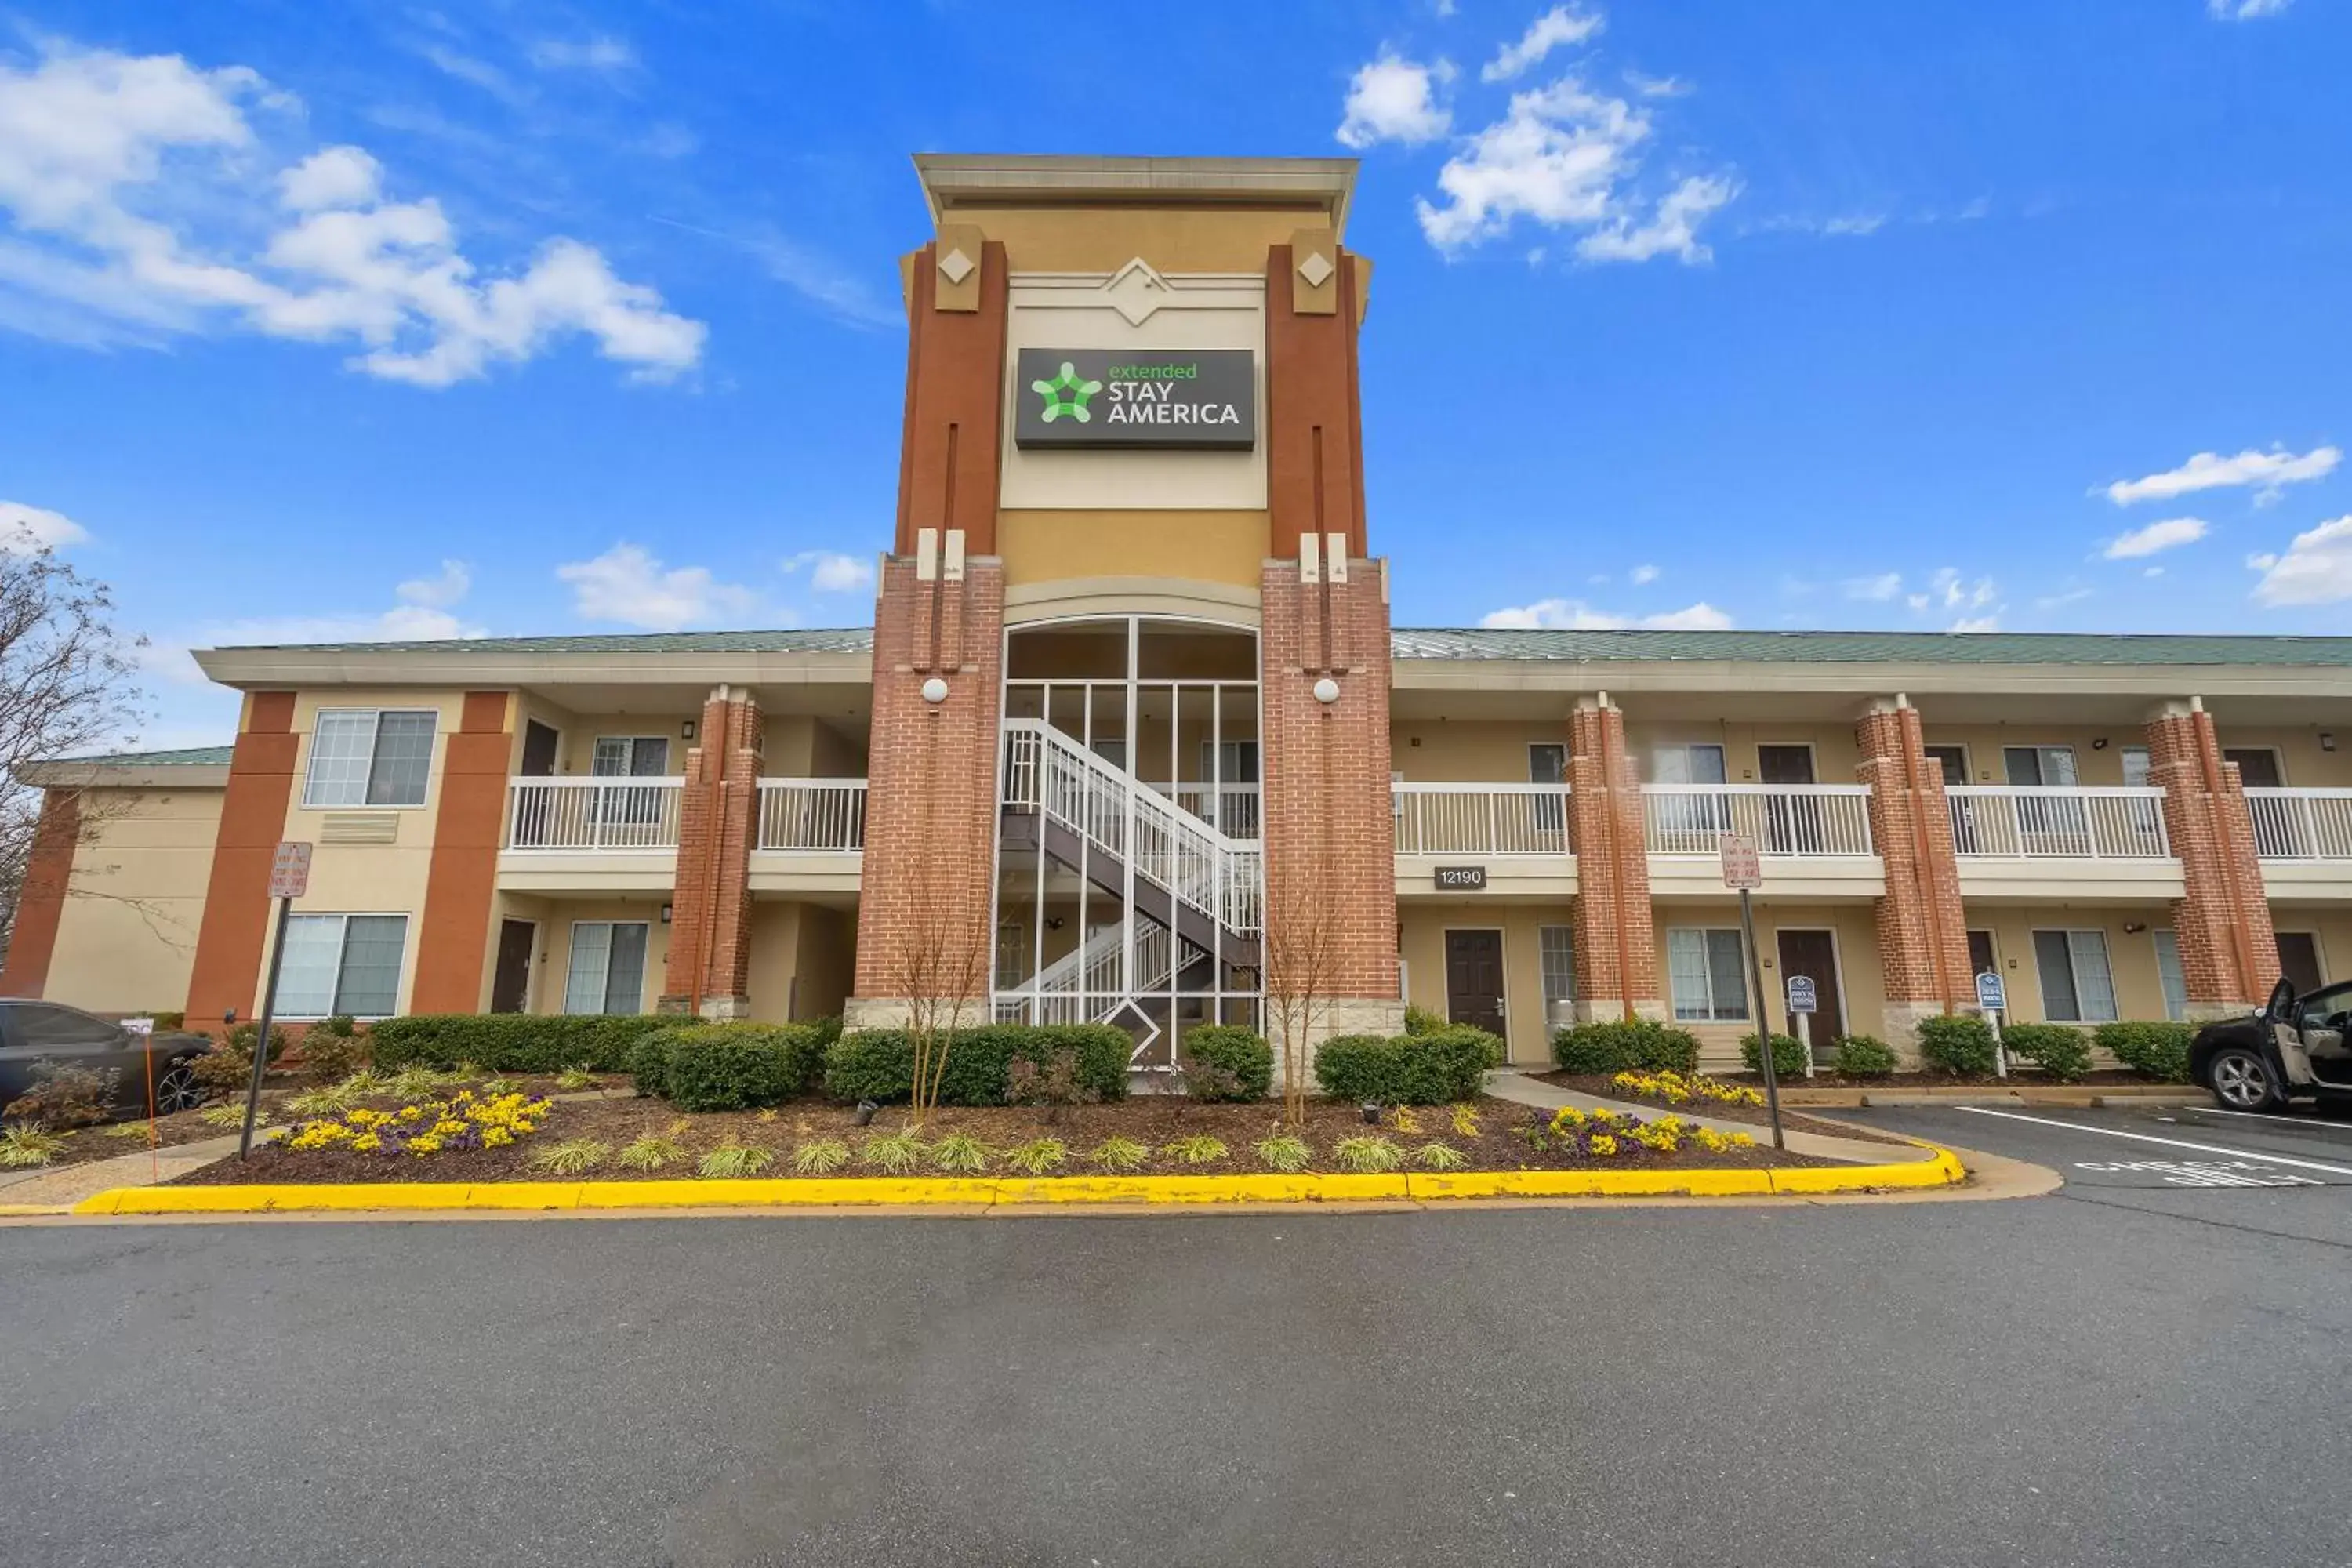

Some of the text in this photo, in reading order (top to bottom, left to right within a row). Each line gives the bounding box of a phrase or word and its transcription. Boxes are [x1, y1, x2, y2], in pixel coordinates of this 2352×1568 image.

[1109, 363, 1197, 379] extended
[1108, 381, 1174, 402] STAY
[1107, 403, 1240, 424] AMERICA
[1441, 871, 1481, 884] 12190
